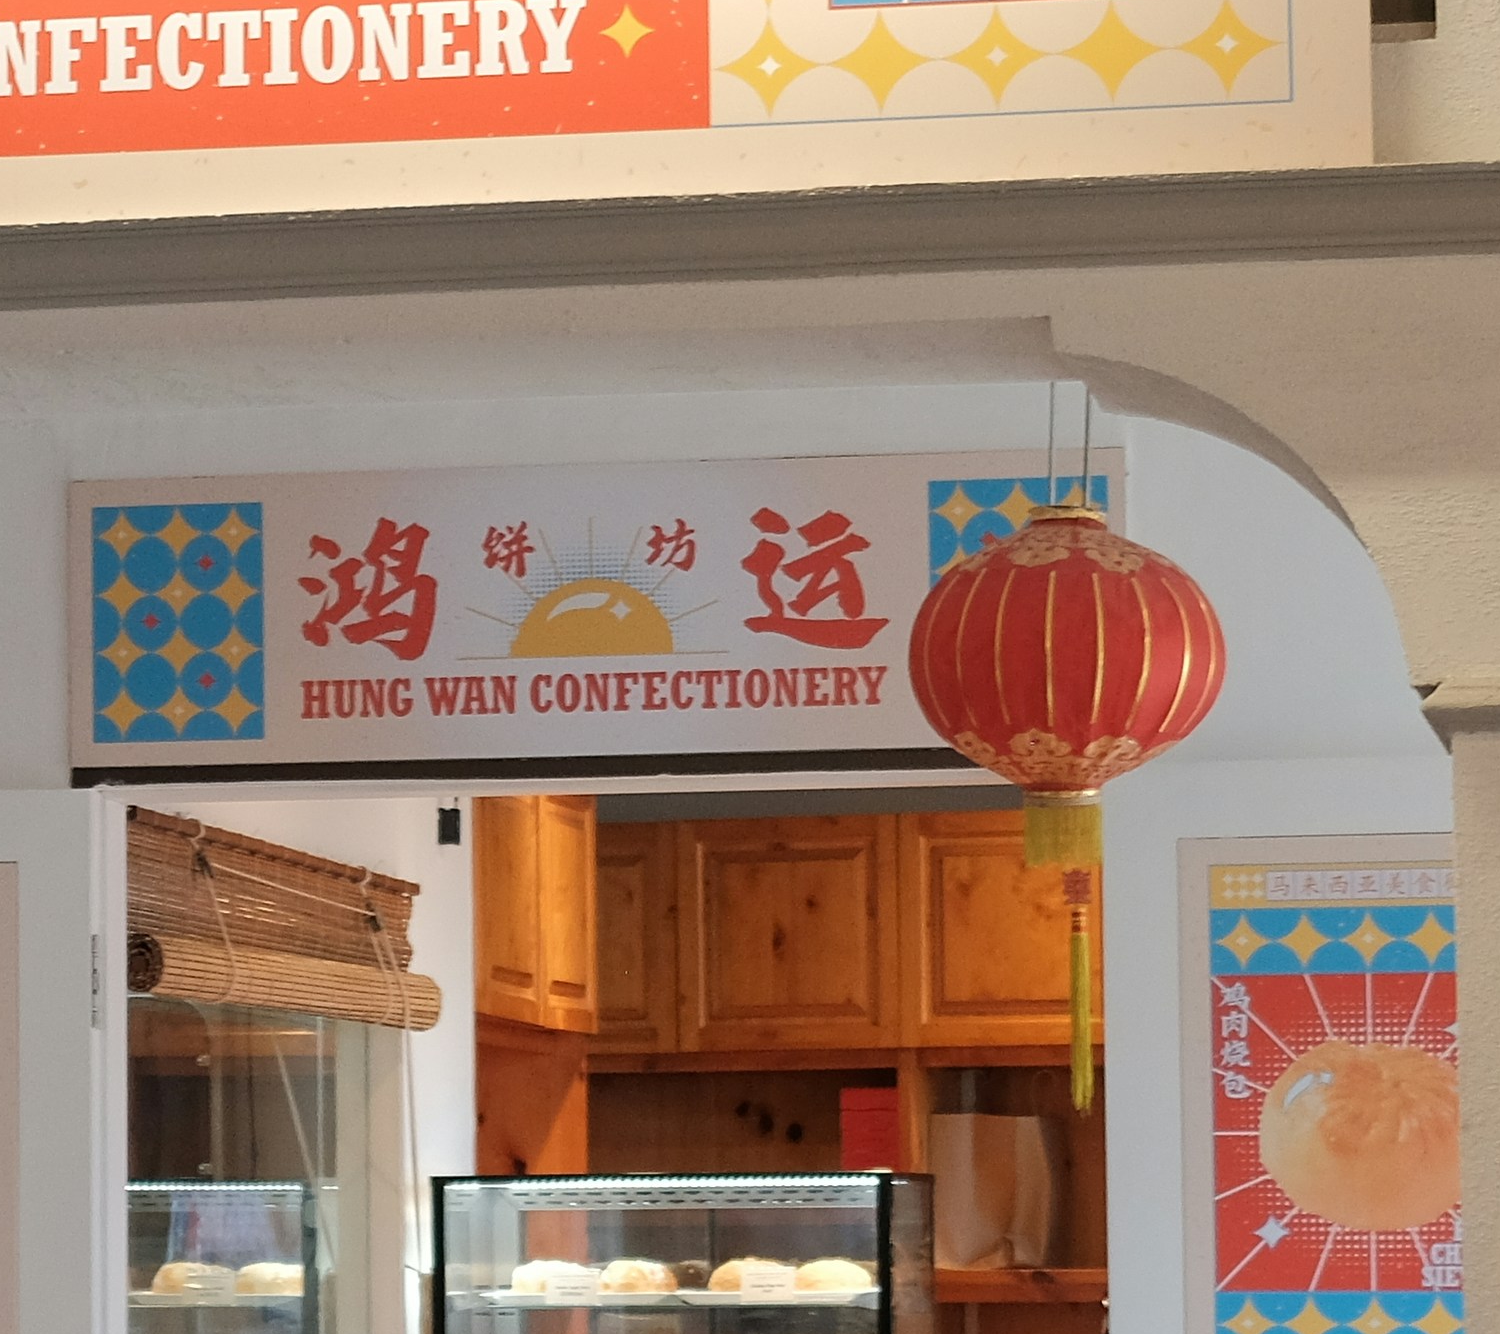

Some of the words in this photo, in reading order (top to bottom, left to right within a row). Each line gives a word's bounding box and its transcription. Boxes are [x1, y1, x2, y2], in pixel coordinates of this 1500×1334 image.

[481, 521, 536, 579] 饼
[645, 518, 696, 571] 坊
[298, 517, 437, 661] 鸿
[741, 506, 890, 650] 运
[300, 677, 414, 720] HUNG
[425, 674, 517, 717] WAN
[530, 666, 888, 713] CONFECTIONERY
